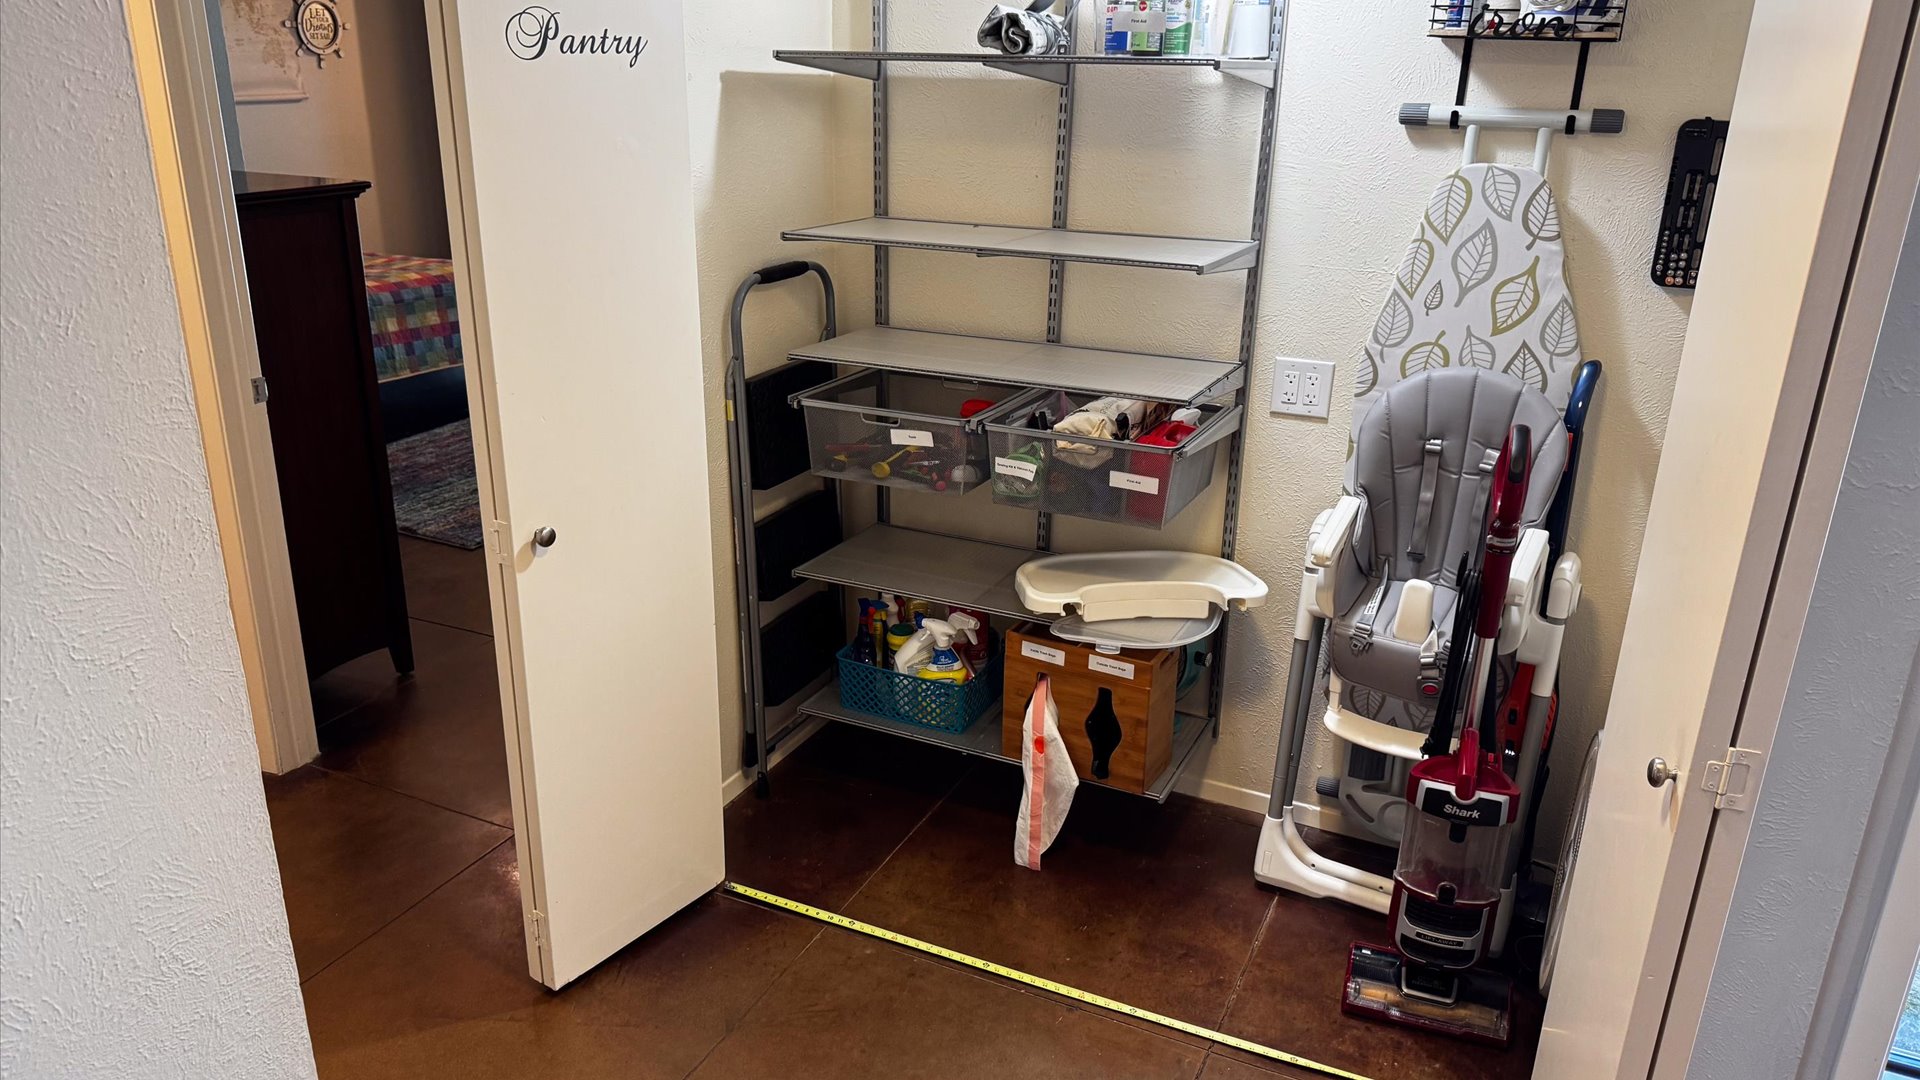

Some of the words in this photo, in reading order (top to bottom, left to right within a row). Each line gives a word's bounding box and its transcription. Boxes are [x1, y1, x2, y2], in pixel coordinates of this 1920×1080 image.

[309, 8, 325, 19] LET
[1470, 4, 1573, 38] iron
[305, 18, 333, 33] Dreams
[505, 6, 648, 68] Pantry
[1443, 804, 1481, 819] Shark
[1421, 934, 1458, 946] LIFT-AWAY
